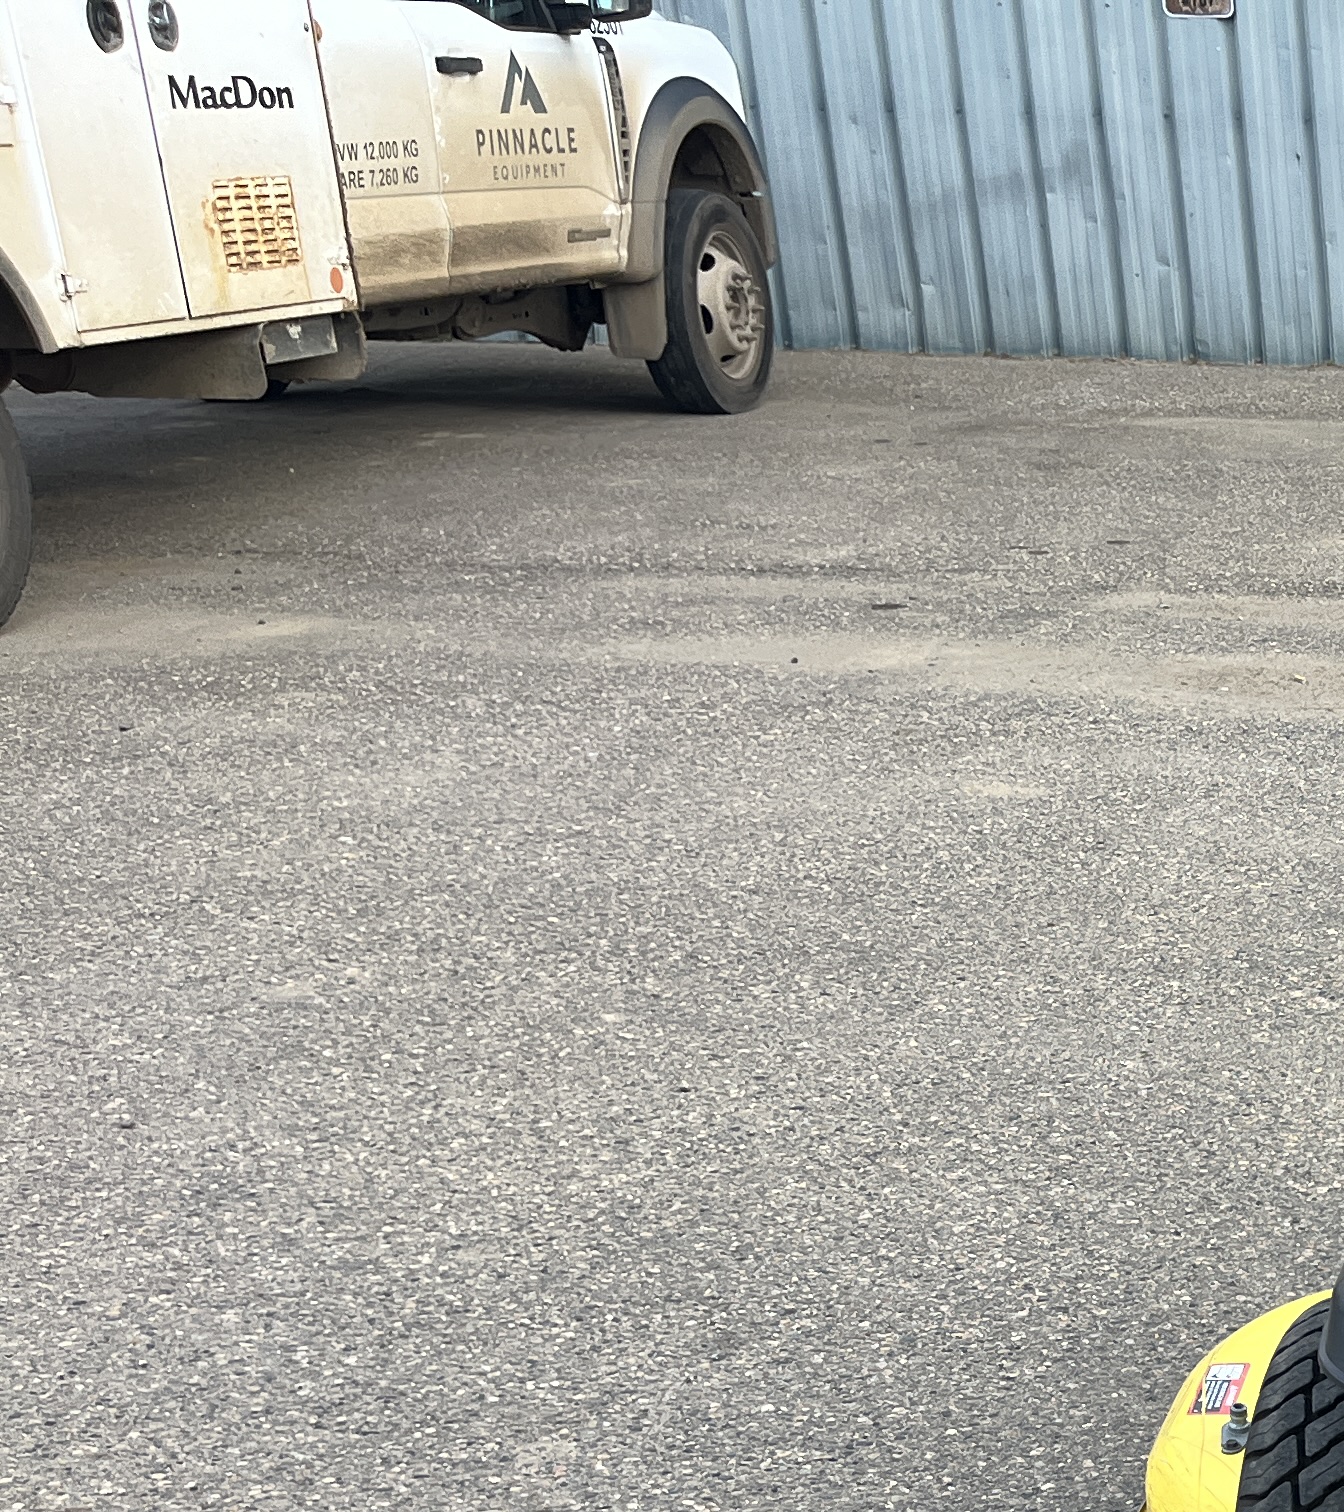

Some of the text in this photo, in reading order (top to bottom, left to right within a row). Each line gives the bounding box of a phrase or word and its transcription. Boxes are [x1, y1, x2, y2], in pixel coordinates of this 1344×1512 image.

[167, 75, 295, 109] MacDon
[363, 140, 399, 162] 12,000
[402, 139, 419, 158] KG
[475, 127, 578, 156] PINNACLE
[369, 167, 399, 189] 7,260
[402, 165, 419, 184] KG
[493, 162, 566, 181] EQUIPMENT
